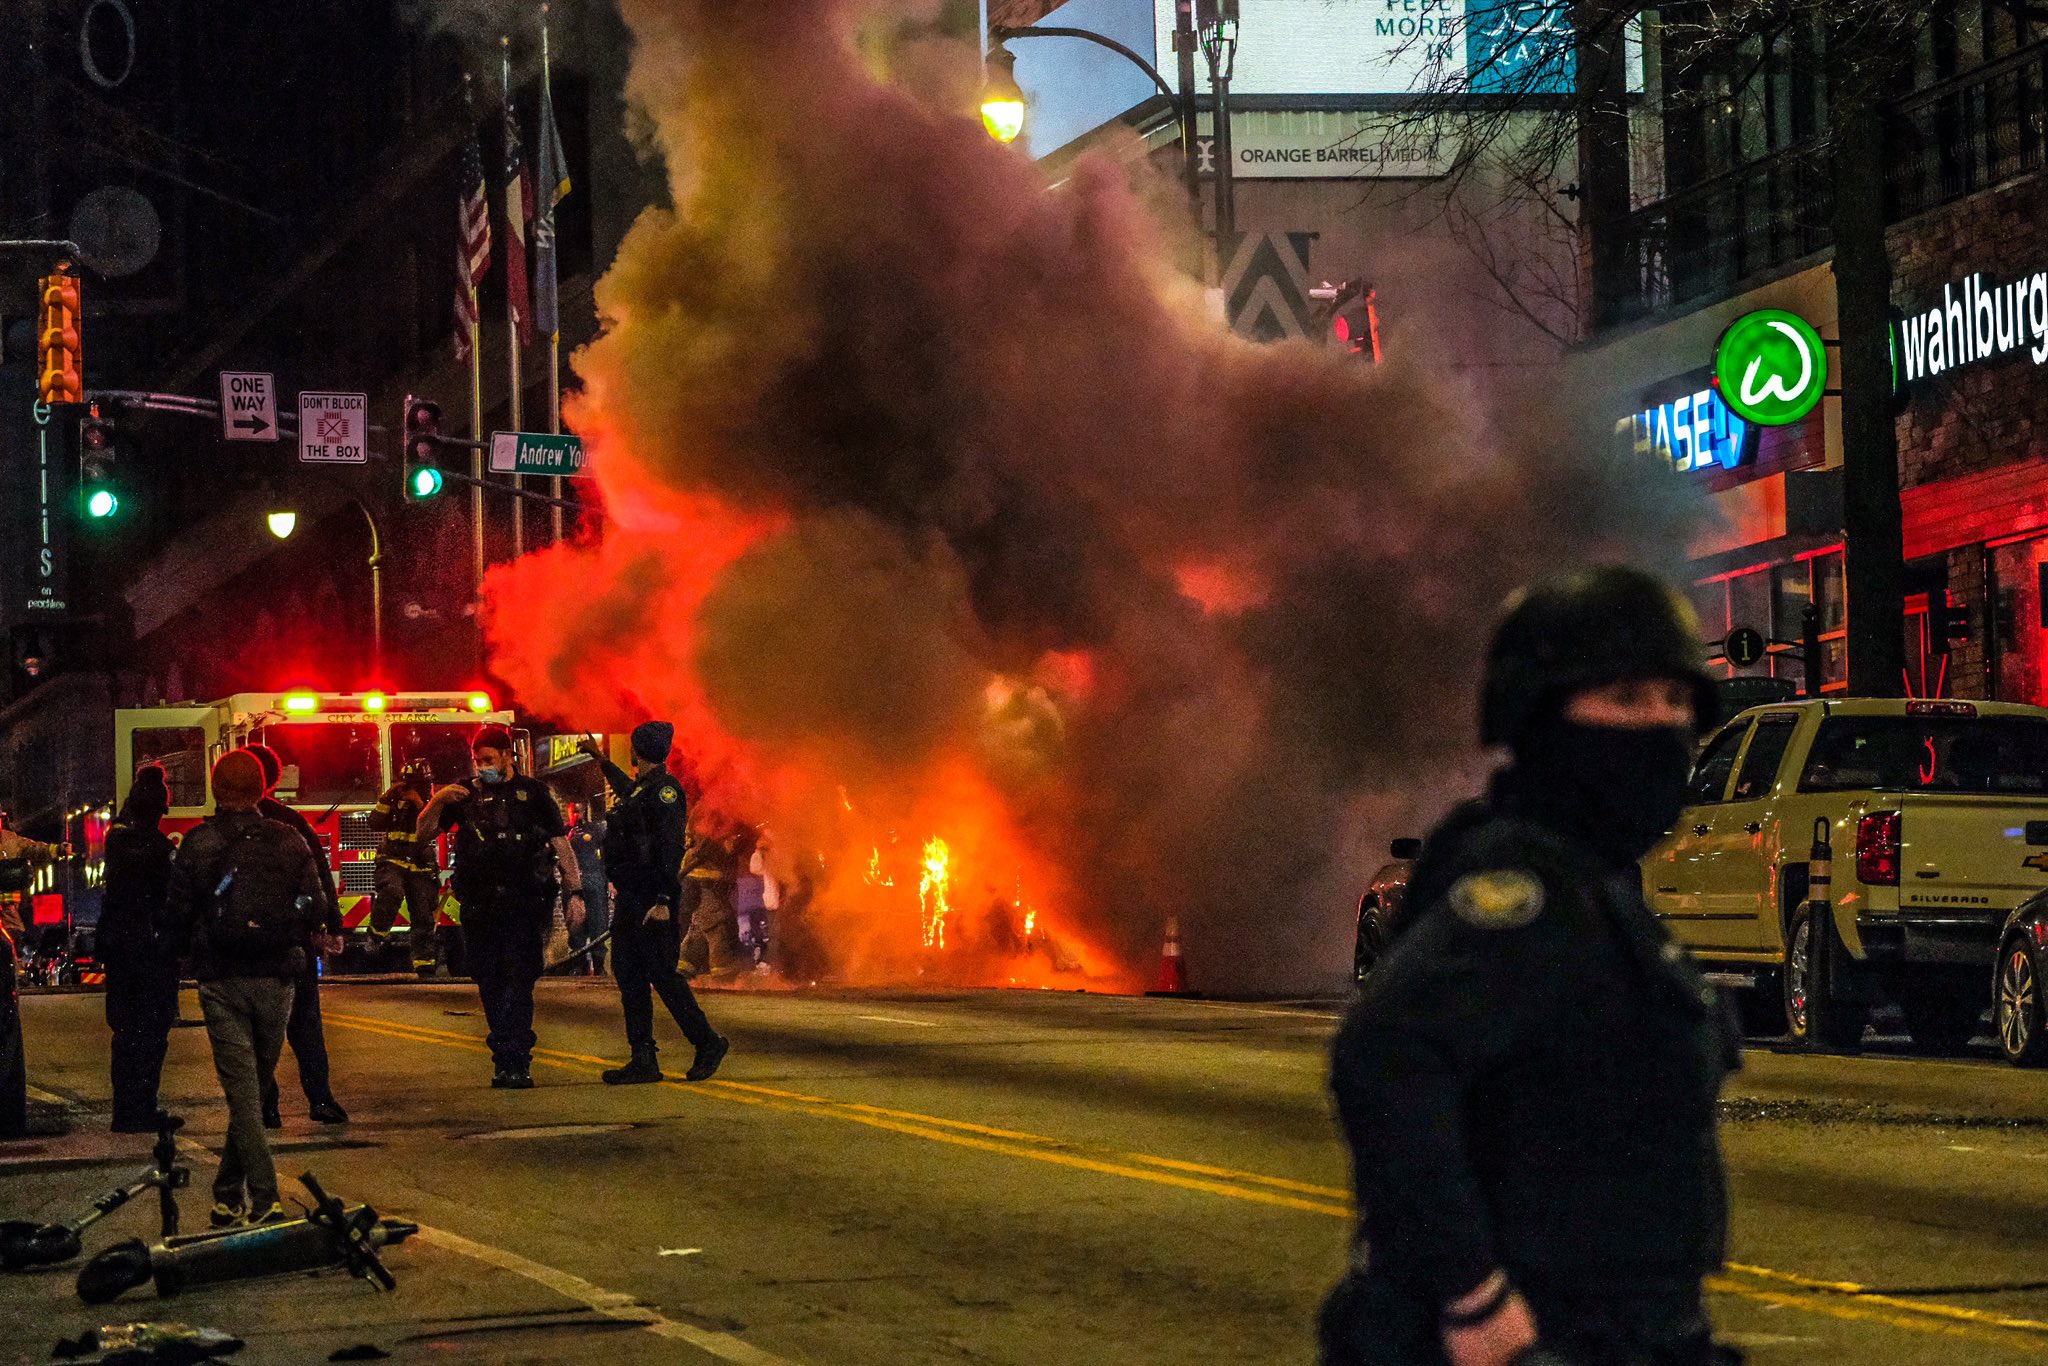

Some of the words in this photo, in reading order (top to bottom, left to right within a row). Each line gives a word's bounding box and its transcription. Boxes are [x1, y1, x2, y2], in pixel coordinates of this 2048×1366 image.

[1375, 18, 1451, 36] MORE
[1428, 42, 1453, 60] IN
[1240, 149, 1311, 163] ORANGE
[1316, 148, 1379, 163] BARREL
[1388, 149, 1438, 163] MEDIA
[230, 377, 264, 393] ONE
[231, 396, 266, 411] WAY
[303, 397, 329, 409] DON'T
[332, 397, 363, 410] BLOCK
[306, 445, 330, 457] THE
[336, 445, 361, 458] BOX
[519, 442, 564, 466] Andrew
[569, 445, 593, 468] You
[327, 713, 357, 723] CITY
[362, 713, 379, 723] OF
[383, 713, 440, 723] ATLANTA
[1910, 894, 1990, 905] SILVERADO
